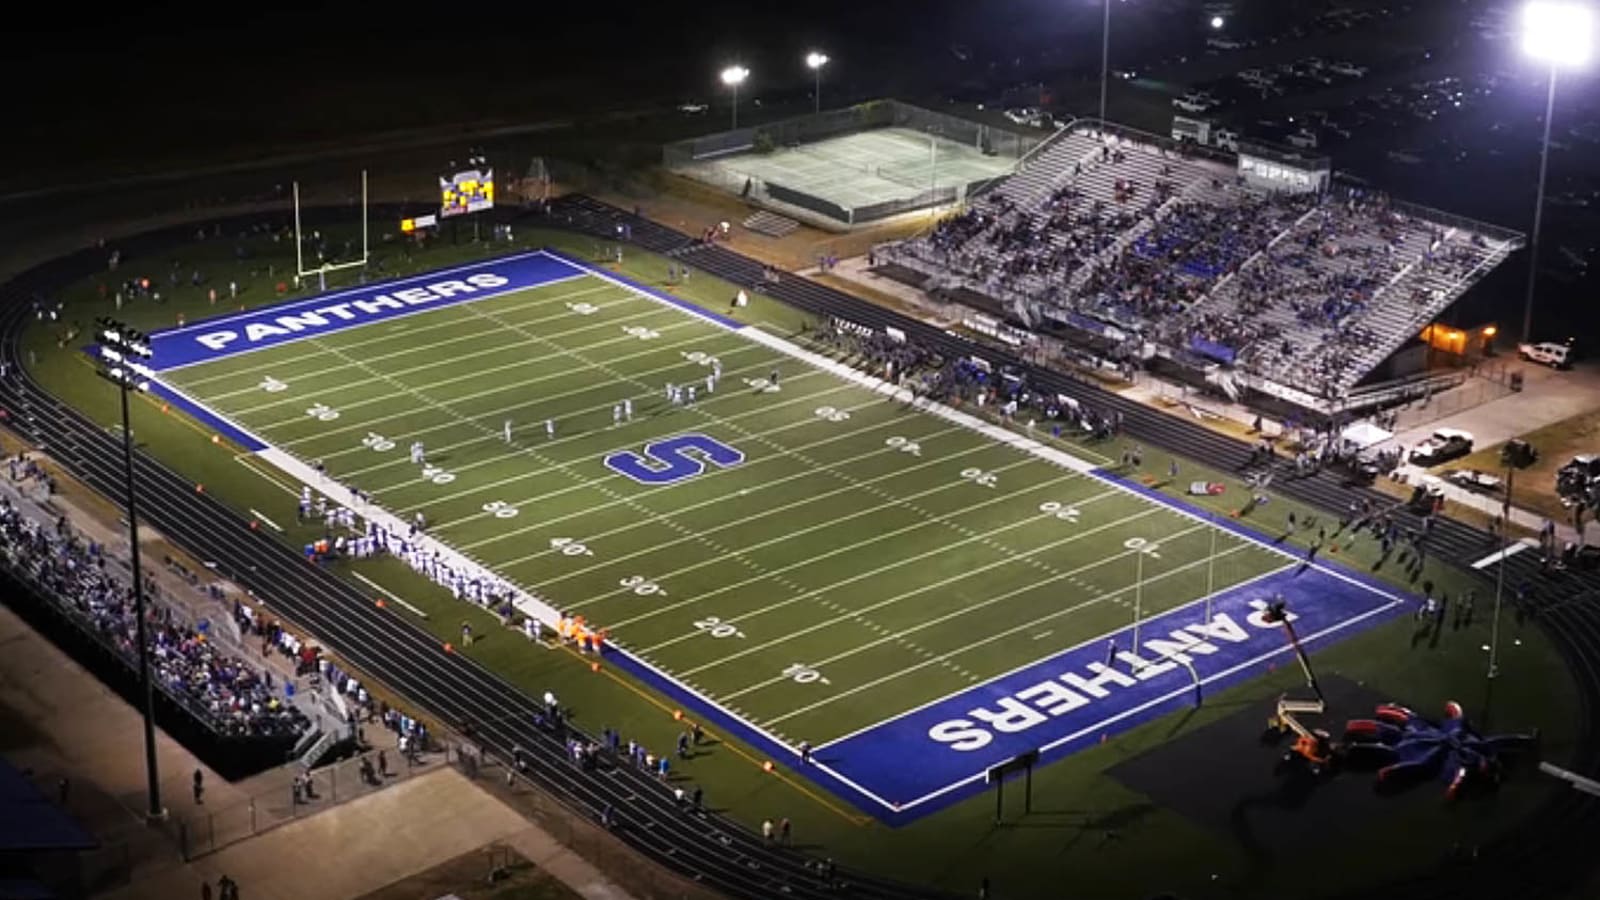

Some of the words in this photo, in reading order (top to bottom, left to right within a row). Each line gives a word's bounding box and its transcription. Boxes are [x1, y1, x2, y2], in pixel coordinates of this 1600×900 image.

[196, 273, 511, 350] PANTHERS
[604, 433, 745, 484] S
[693, 617, 736, 638] 20
[928, 599, 1296, 752] PANTHERS
